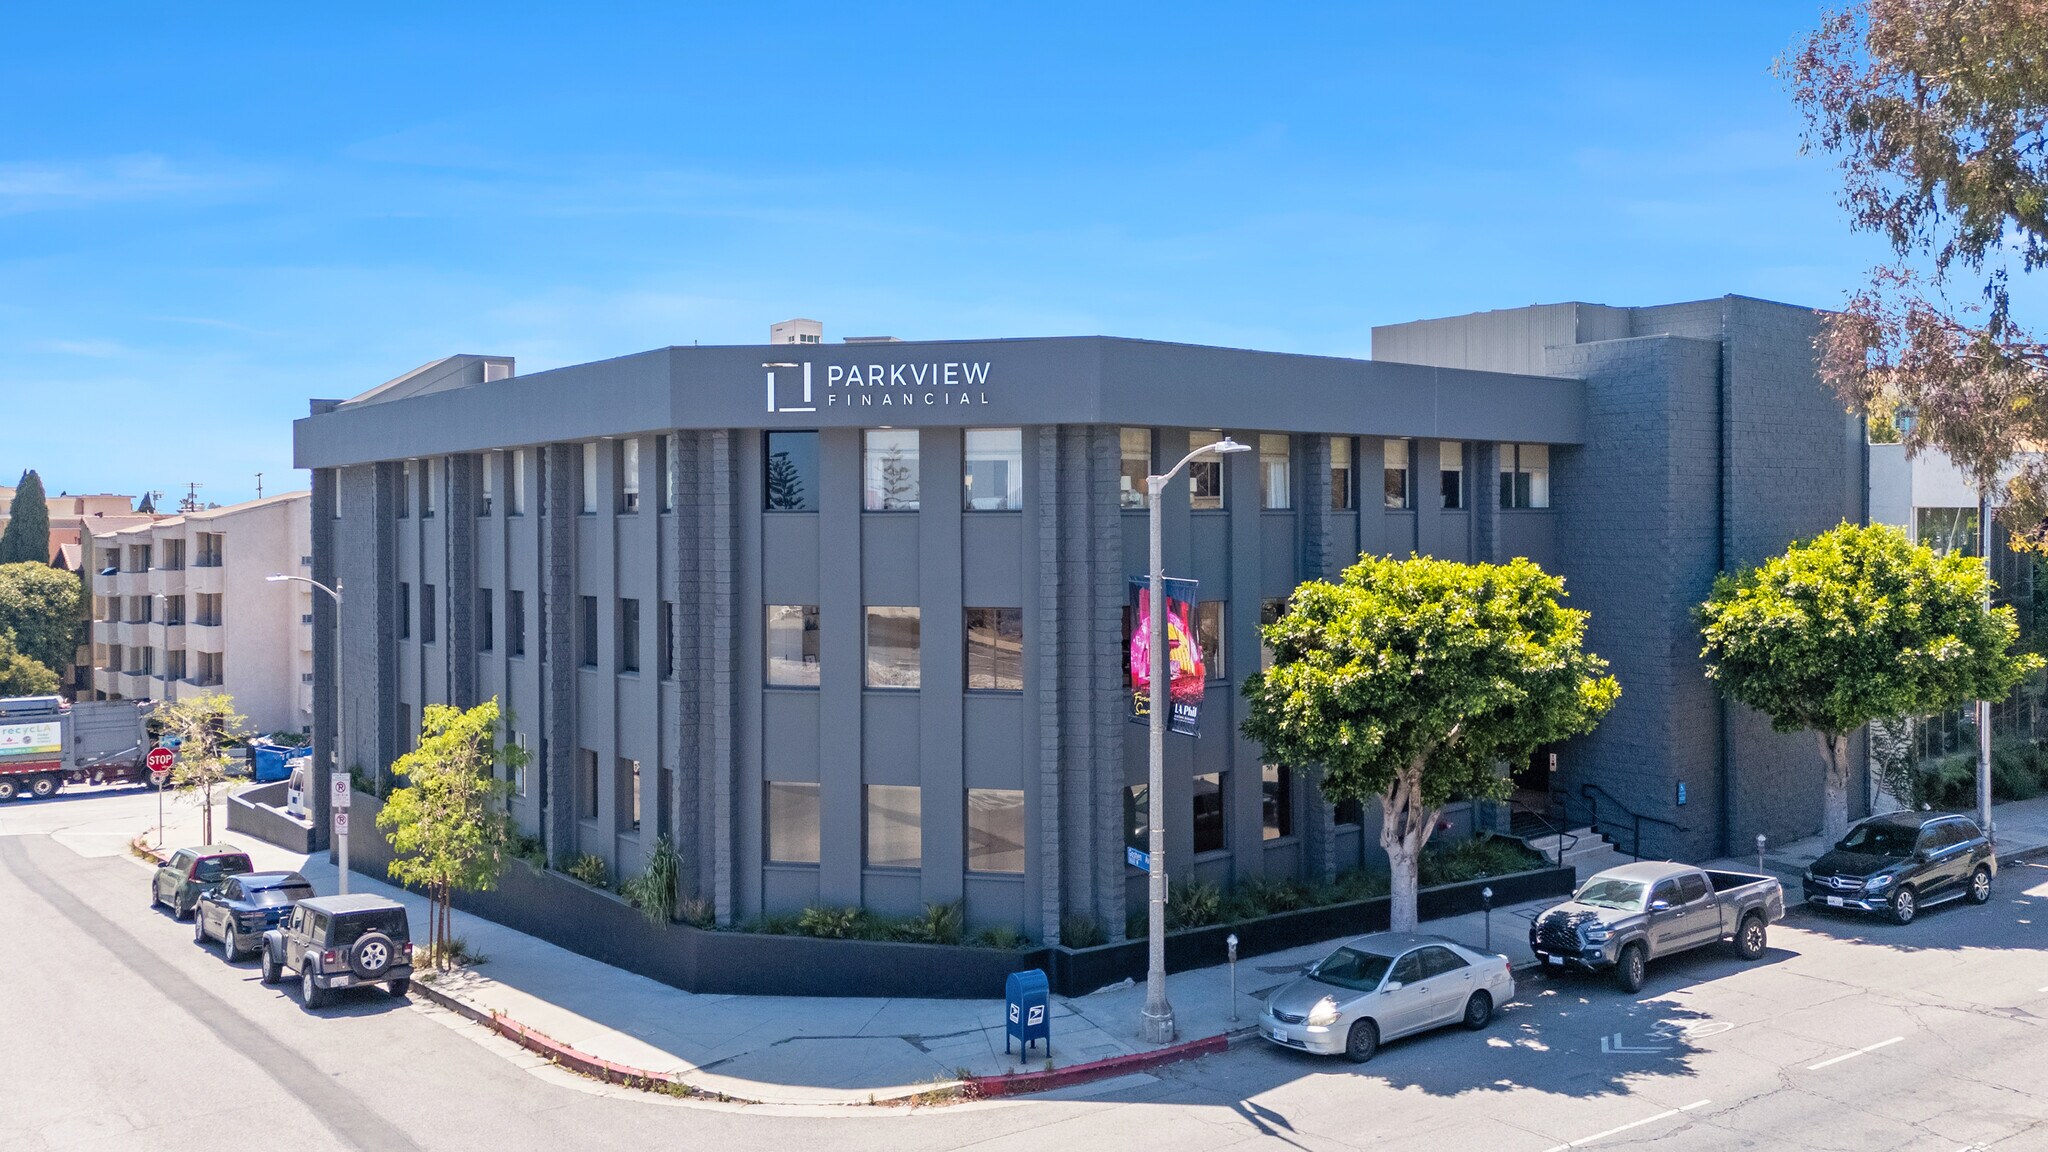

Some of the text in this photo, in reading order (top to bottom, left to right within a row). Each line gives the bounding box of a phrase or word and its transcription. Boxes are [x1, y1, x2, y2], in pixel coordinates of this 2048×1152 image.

[828, 362, 991, 387] PARKVIEW
[828, 392, 989, 406] FINANCIAL
[1174, 703, 1198, 718] LA Phil
[149, 754, 172, 765] STOP
